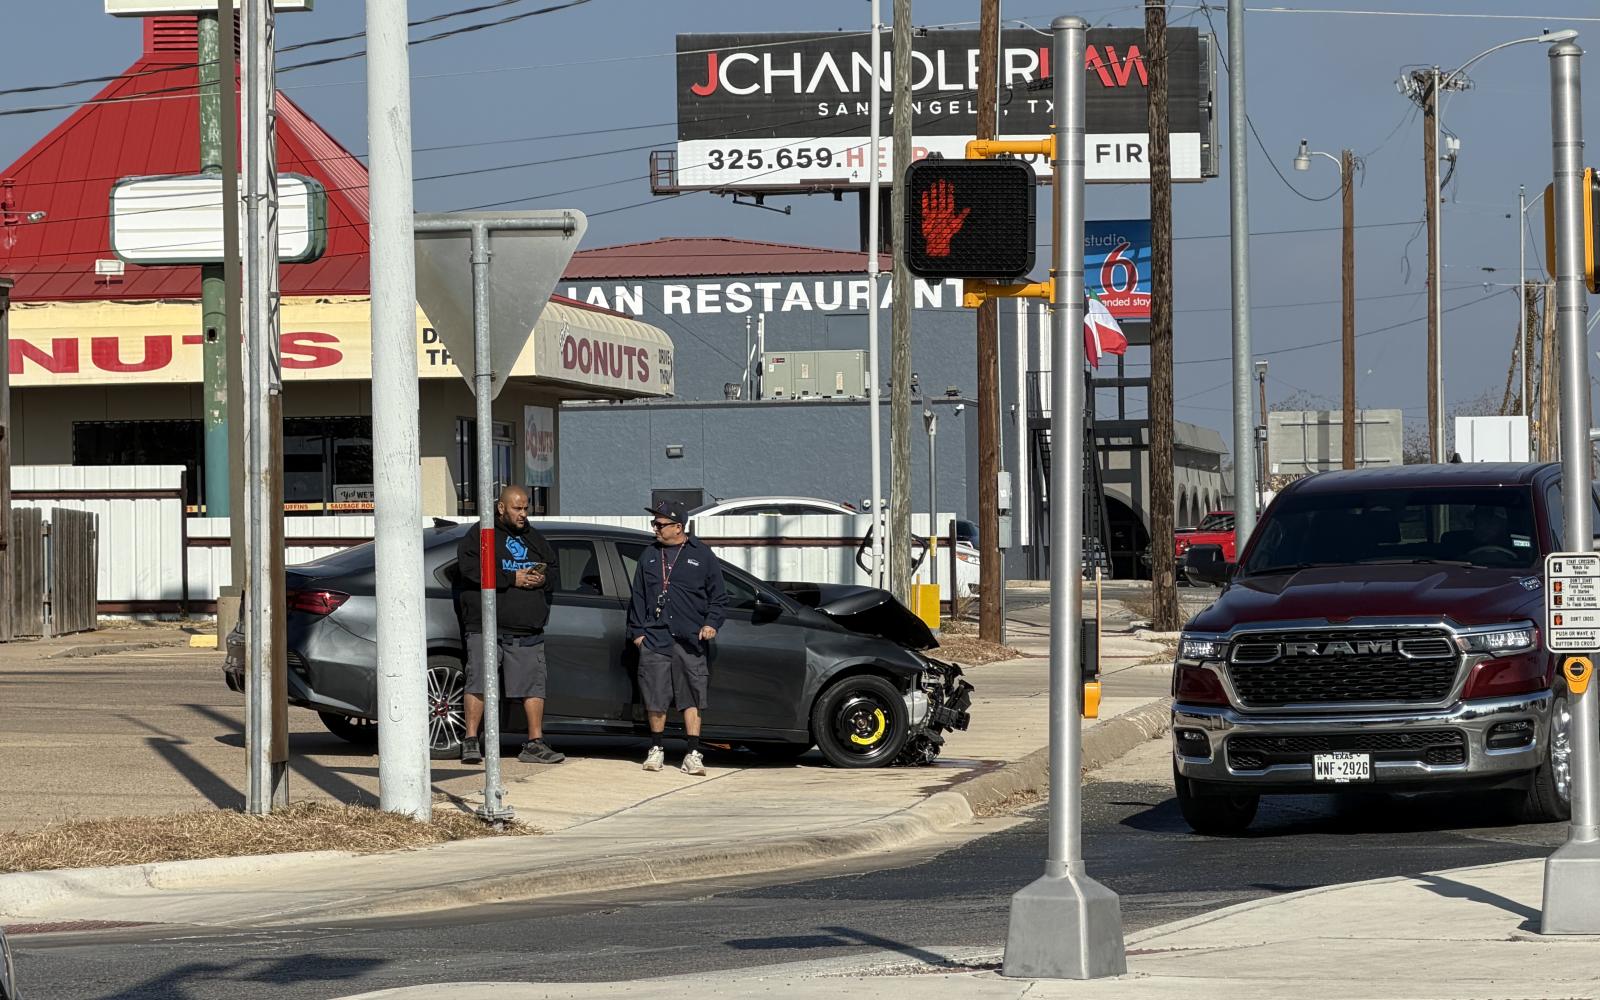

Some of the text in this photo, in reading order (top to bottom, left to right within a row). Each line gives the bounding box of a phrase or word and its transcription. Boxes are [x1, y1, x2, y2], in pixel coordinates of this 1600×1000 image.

[818, 102, 869, 116] SAN
[1027, 99, 1054, 114] TX
[1095, 143, 1149, 164] FIR
[1084, 233, 1127, 247] studio
[1099, 241, 1139, 297] 6
[1132, 297, 1152, 308] stay
[562, 335, 650, 383] DONUTS
[1285, 640, 1393, 656] RAM
[1332, 752, 1354, 760] TEXAS
